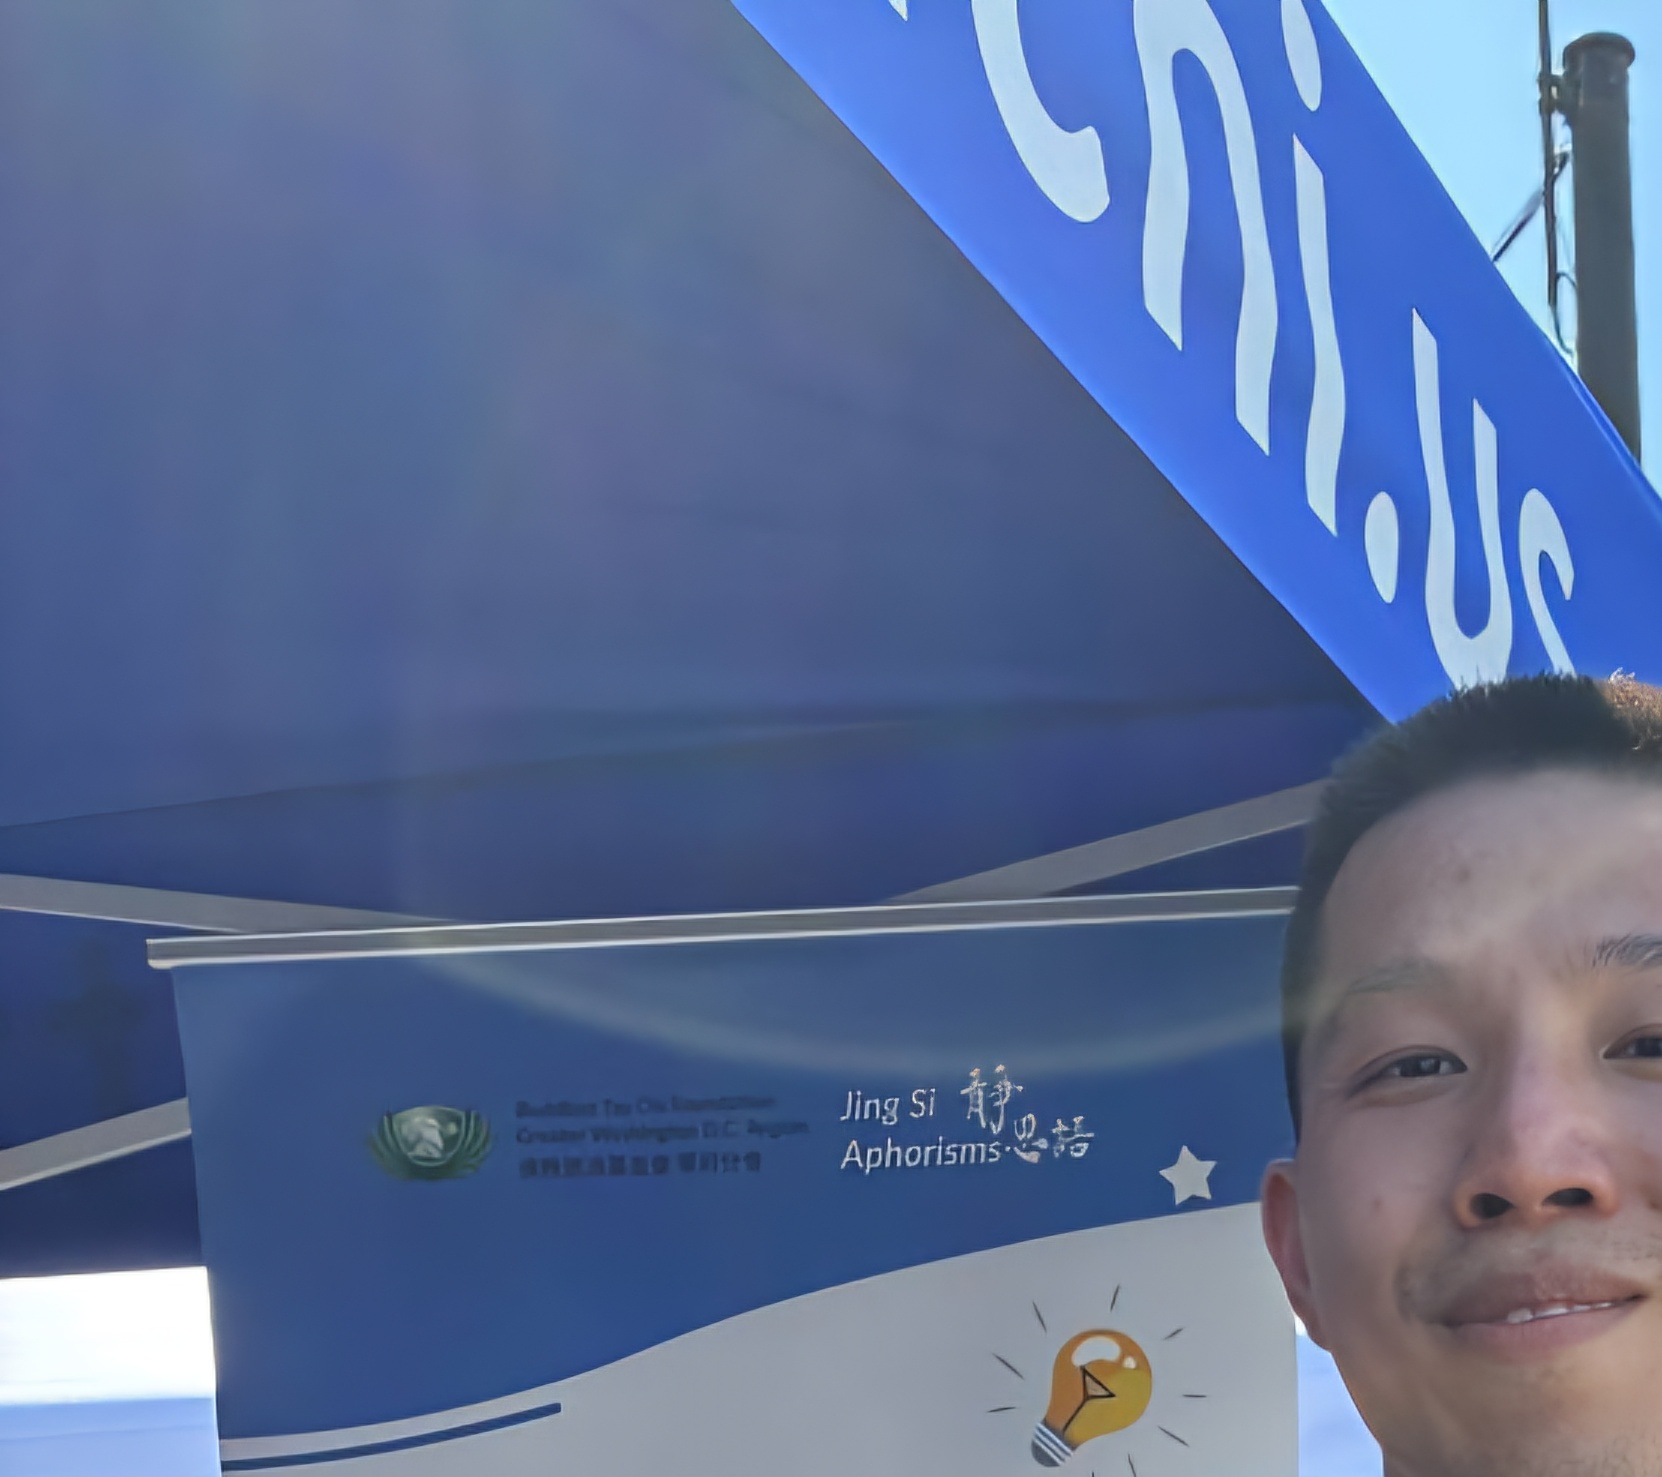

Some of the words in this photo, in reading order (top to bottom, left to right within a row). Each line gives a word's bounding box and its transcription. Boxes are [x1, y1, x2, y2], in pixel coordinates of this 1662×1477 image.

[888, 0, 1574, 690] chi.us
[839, 1090, 899, 1126] Jing
[840, 1136, 1001, 1175] Aphorisms
